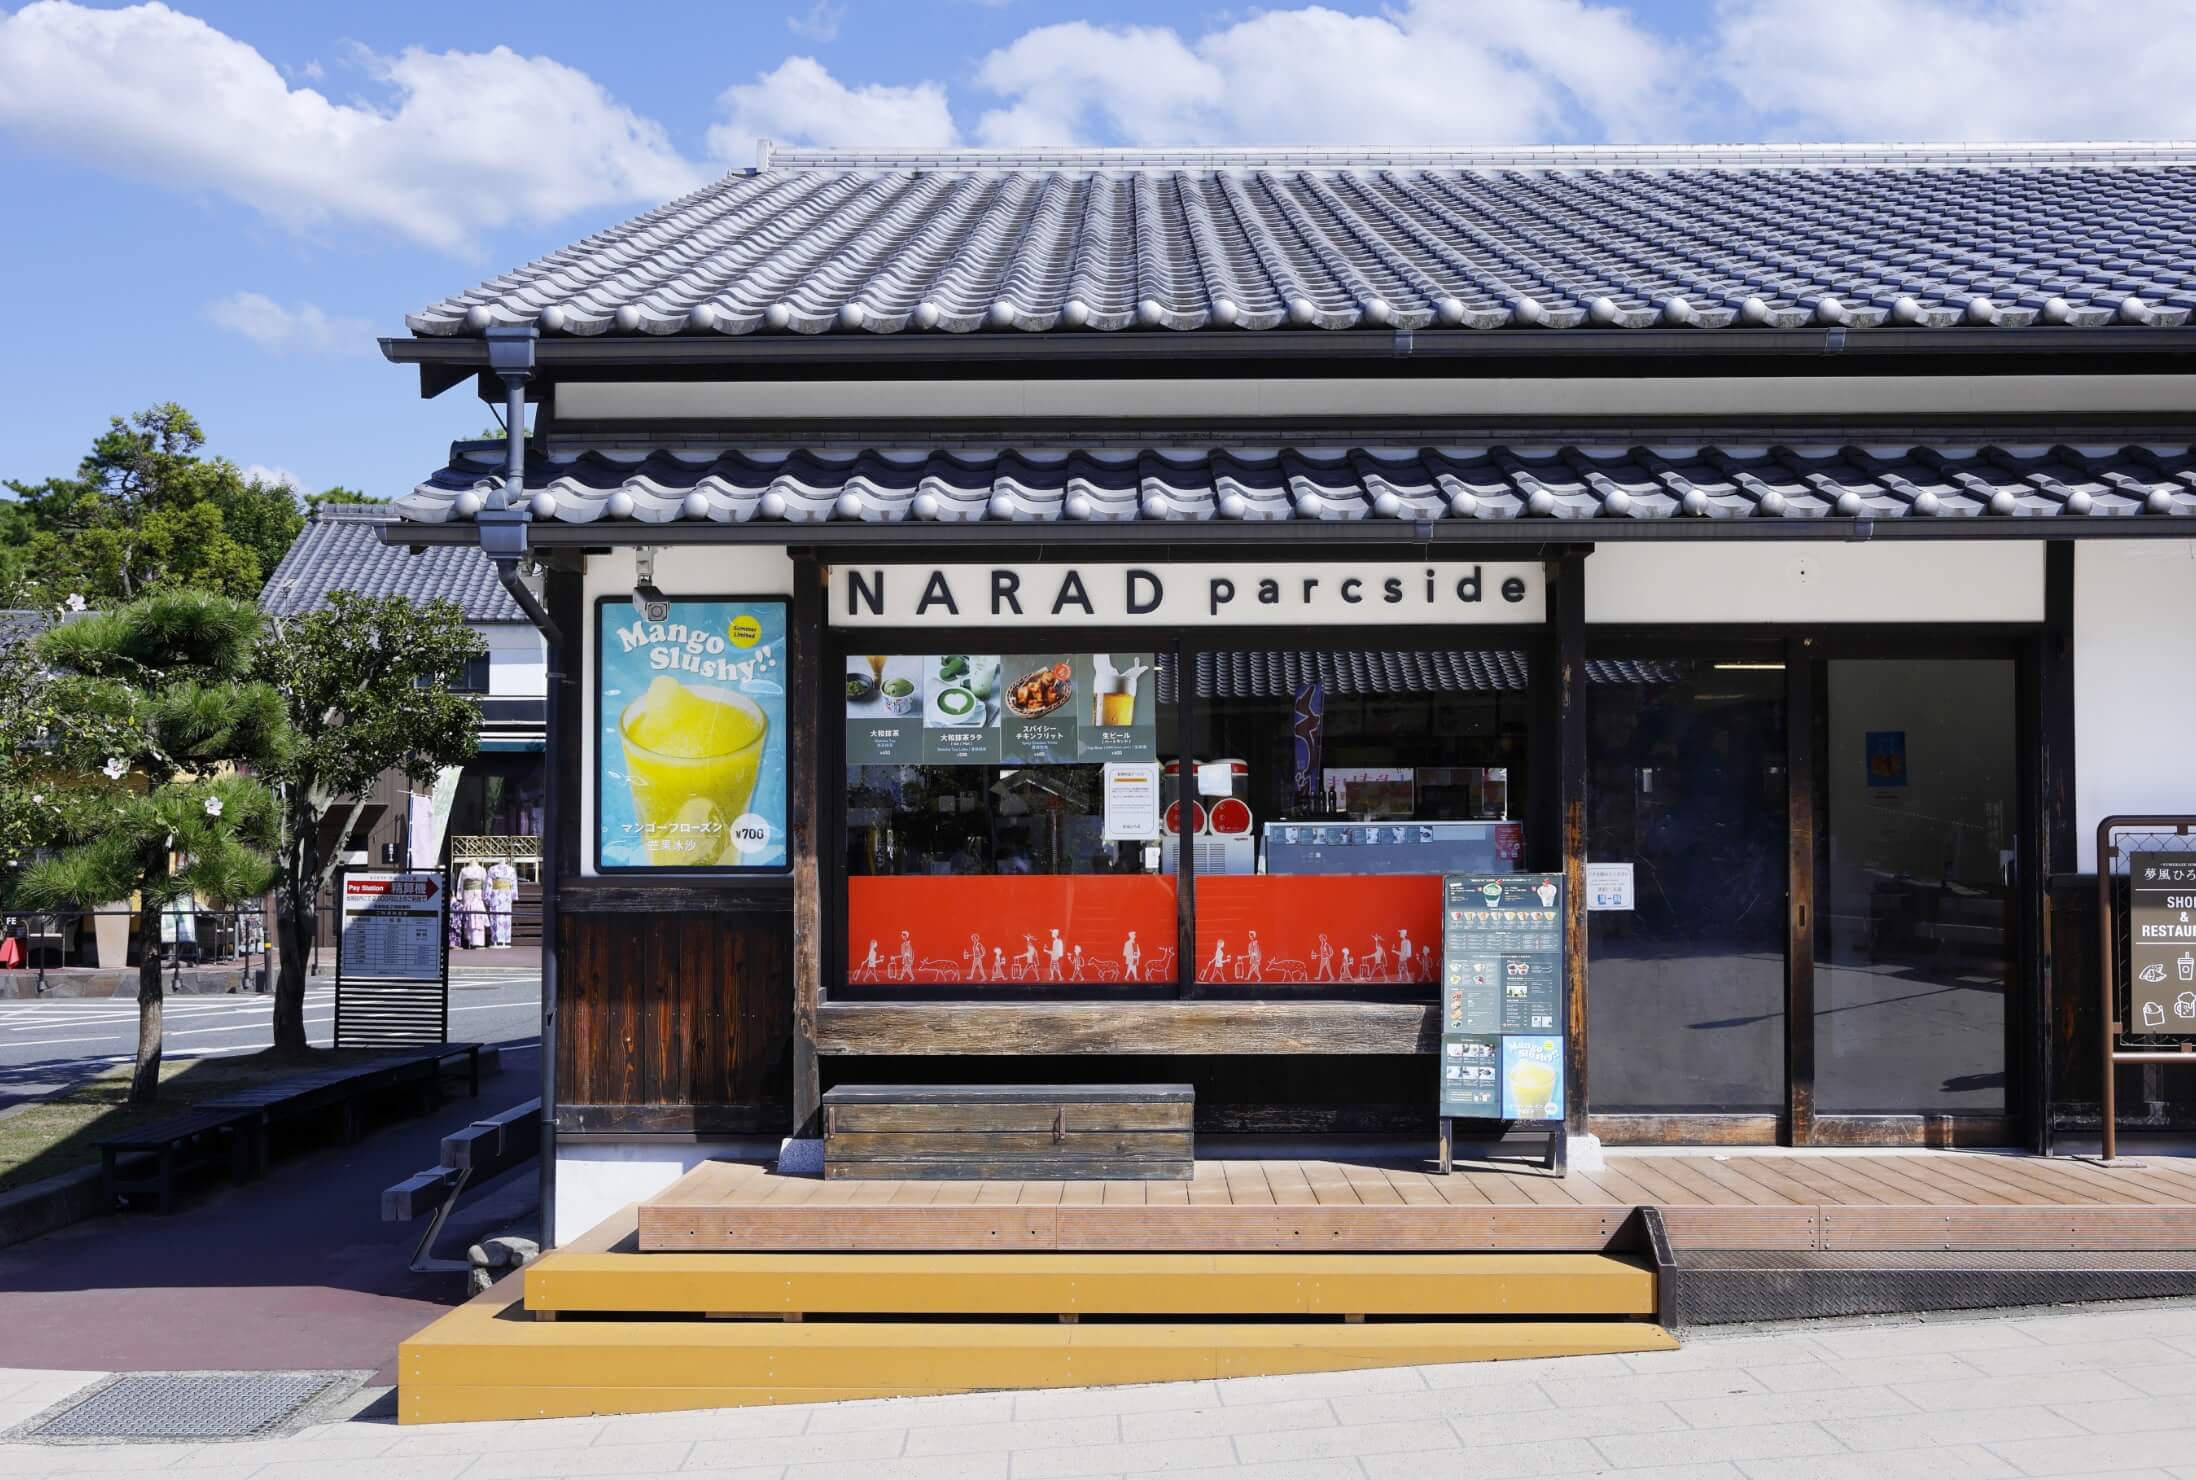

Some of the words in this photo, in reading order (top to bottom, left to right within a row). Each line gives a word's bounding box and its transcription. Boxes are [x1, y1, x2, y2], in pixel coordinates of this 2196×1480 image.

[847, 569, 1164, 616] NARAD
[1209, 566, 1527, 616] parcside
[616, 621, 725, 655] Mango
[733, 631, 756, 639] Limited
[1015, 732, 1064, 740] チキンフリット
[1102, 732, 1131, 740] 生ビール
[736, 828, 765, 840] ¥700
[348, 884, 361, 892] Pay
[2167, 895, 2196, 909] SHO
[2180, 911, 2189, 922] &
